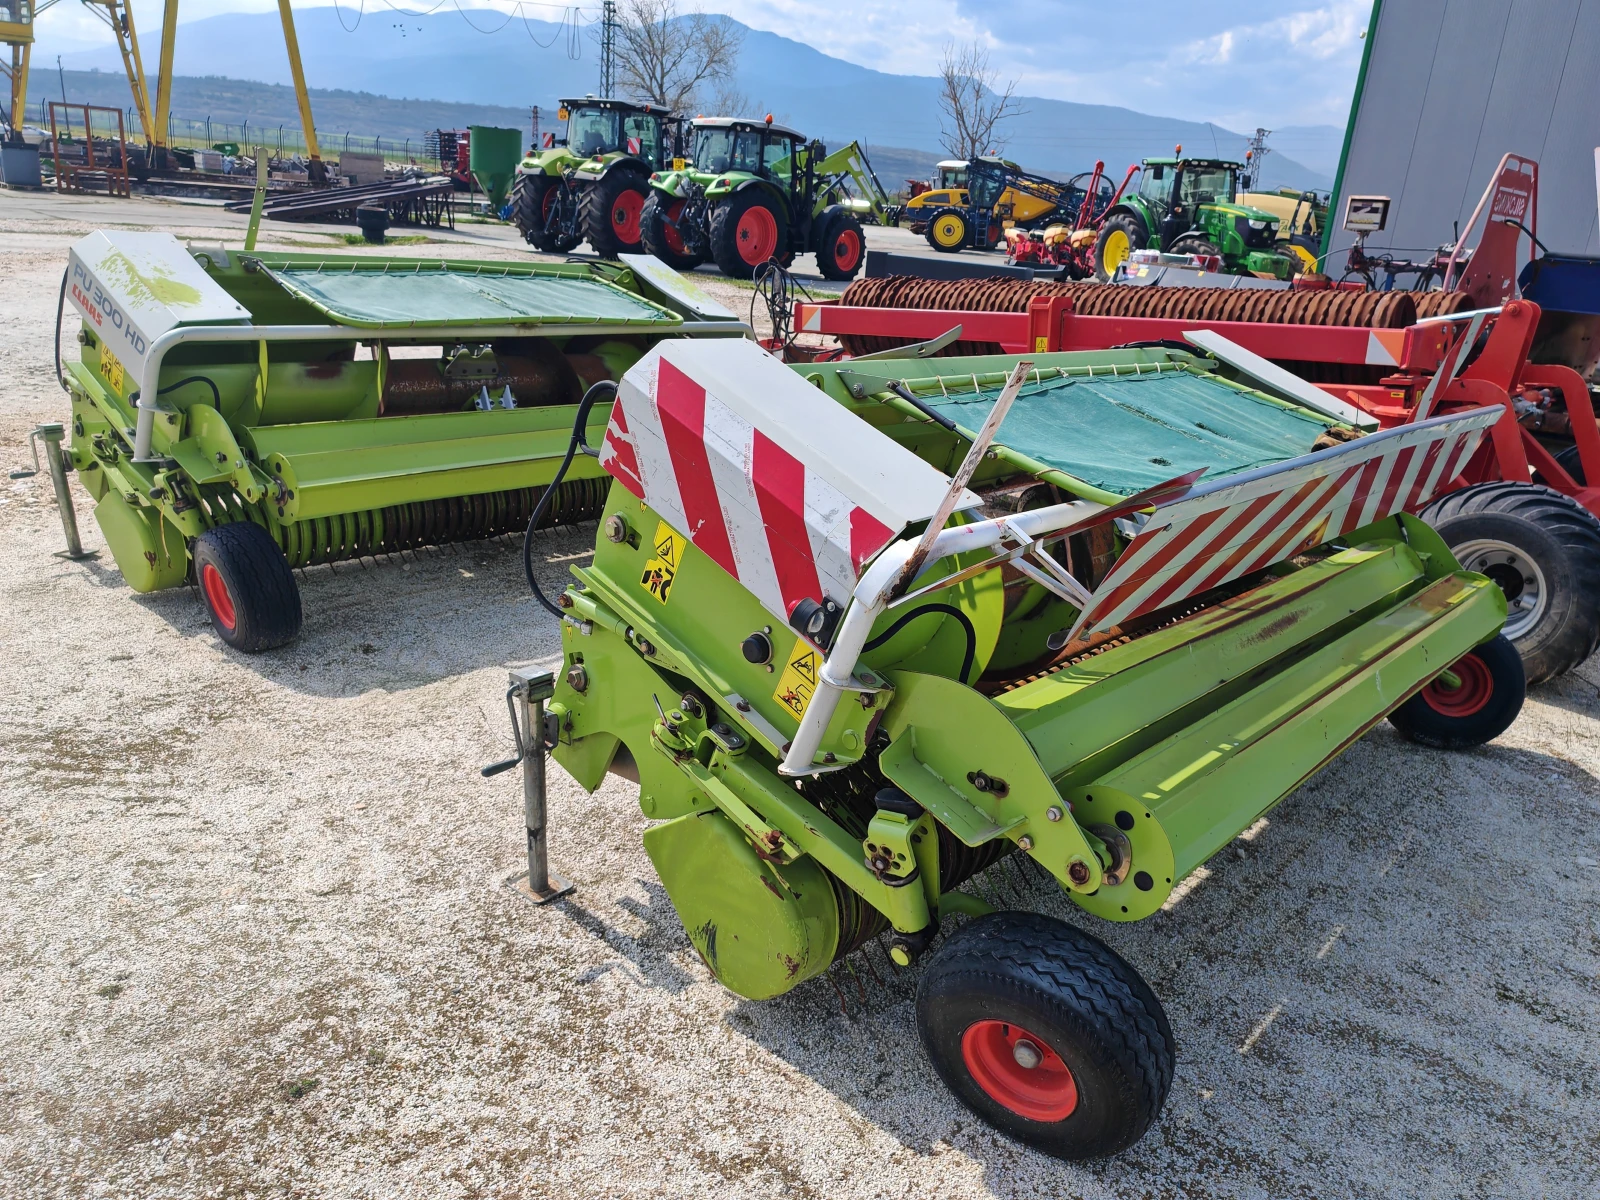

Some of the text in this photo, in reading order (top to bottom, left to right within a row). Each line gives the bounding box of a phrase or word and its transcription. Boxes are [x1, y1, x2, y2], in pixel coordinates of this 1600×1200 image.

[72, 283, 103, 327] CLAAS
[73, 263, 146, 356] PU 300 HD
